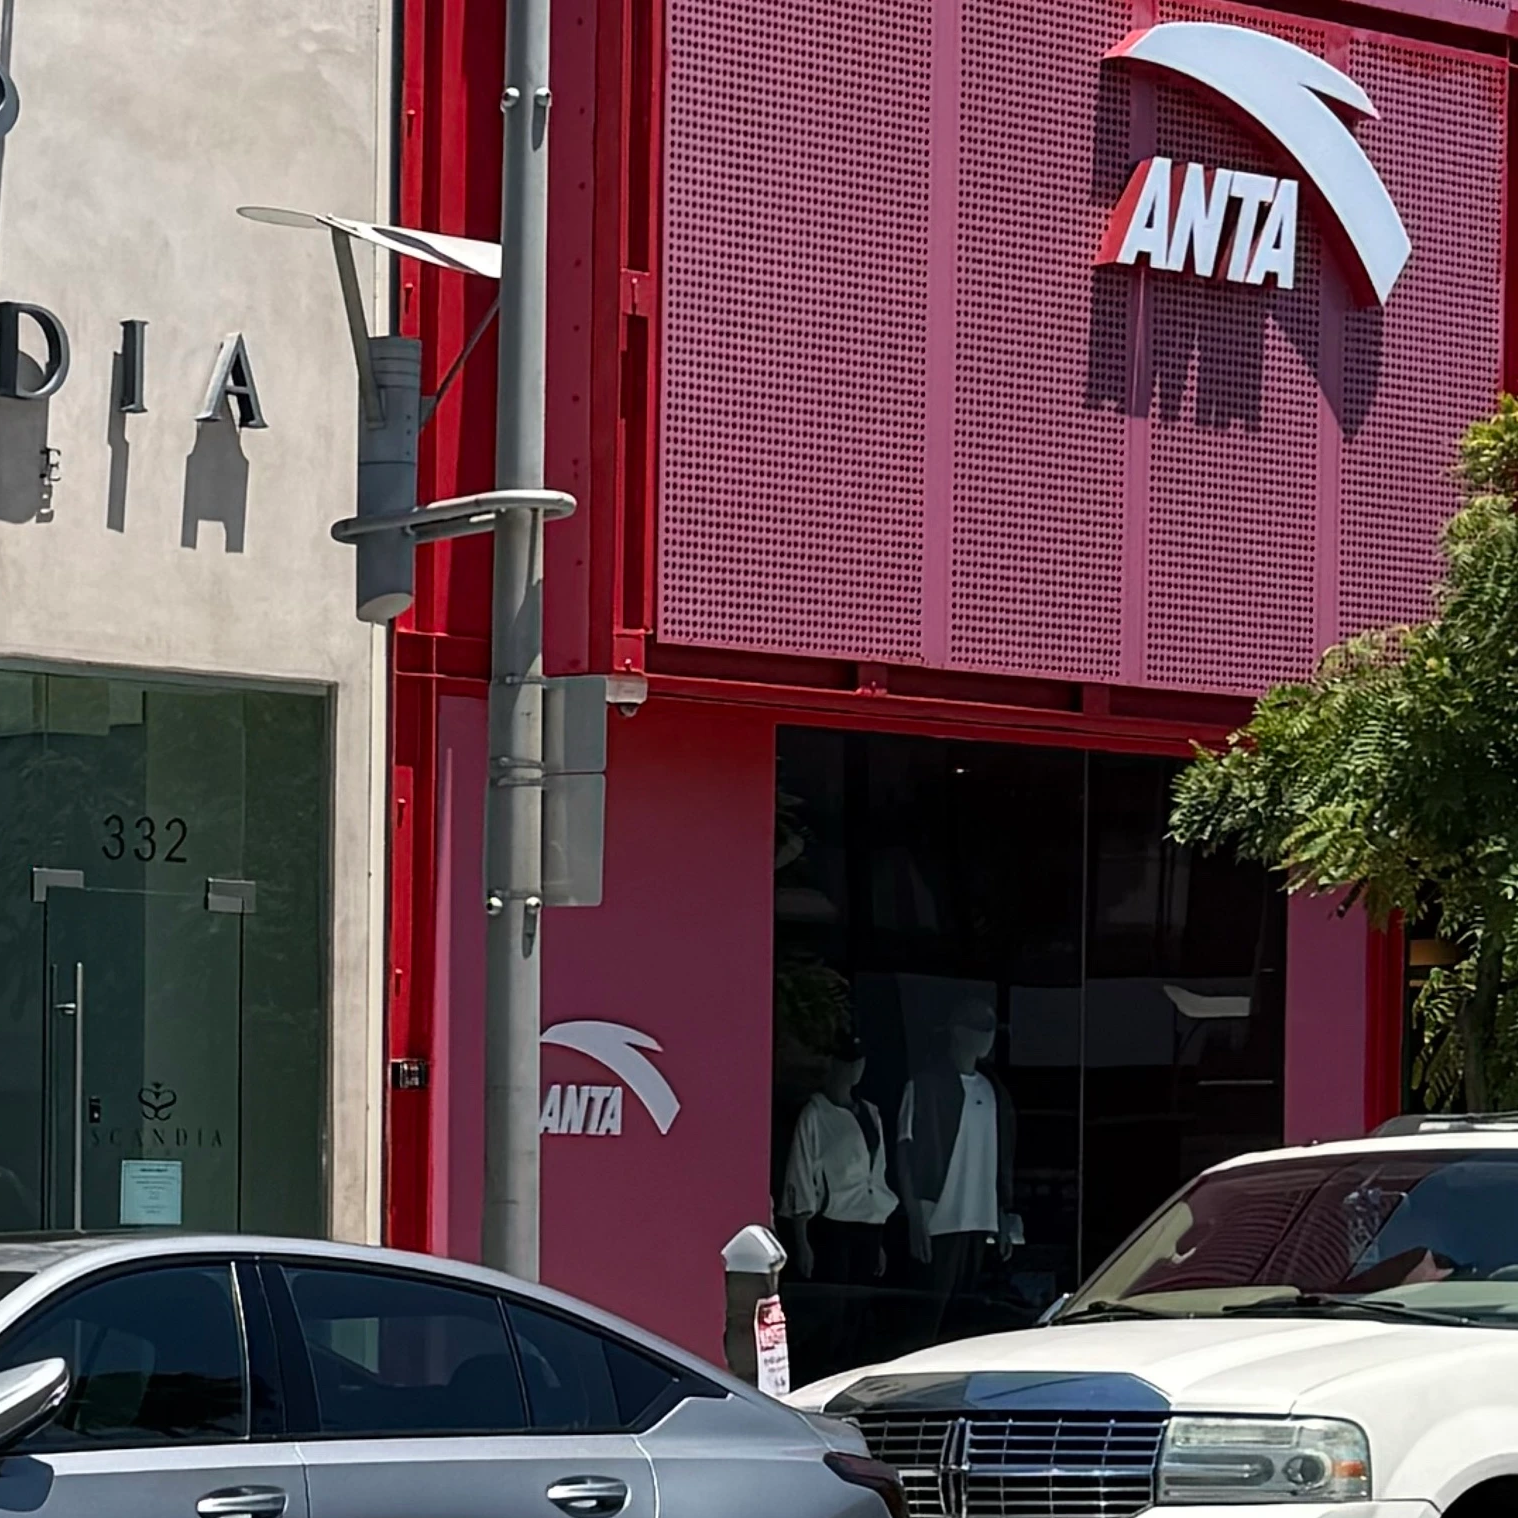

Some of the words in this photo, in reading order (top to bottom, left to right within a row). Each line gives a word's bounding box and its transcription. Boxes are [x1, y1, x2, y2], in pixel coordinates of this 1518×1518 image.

[1116, 155, 1299, 291] ANTA
[101, 813, 188, 863] 332
[538, 1083, 622, 1135] ANTA
[90, 1127, 223, 1148] SCANDIA
